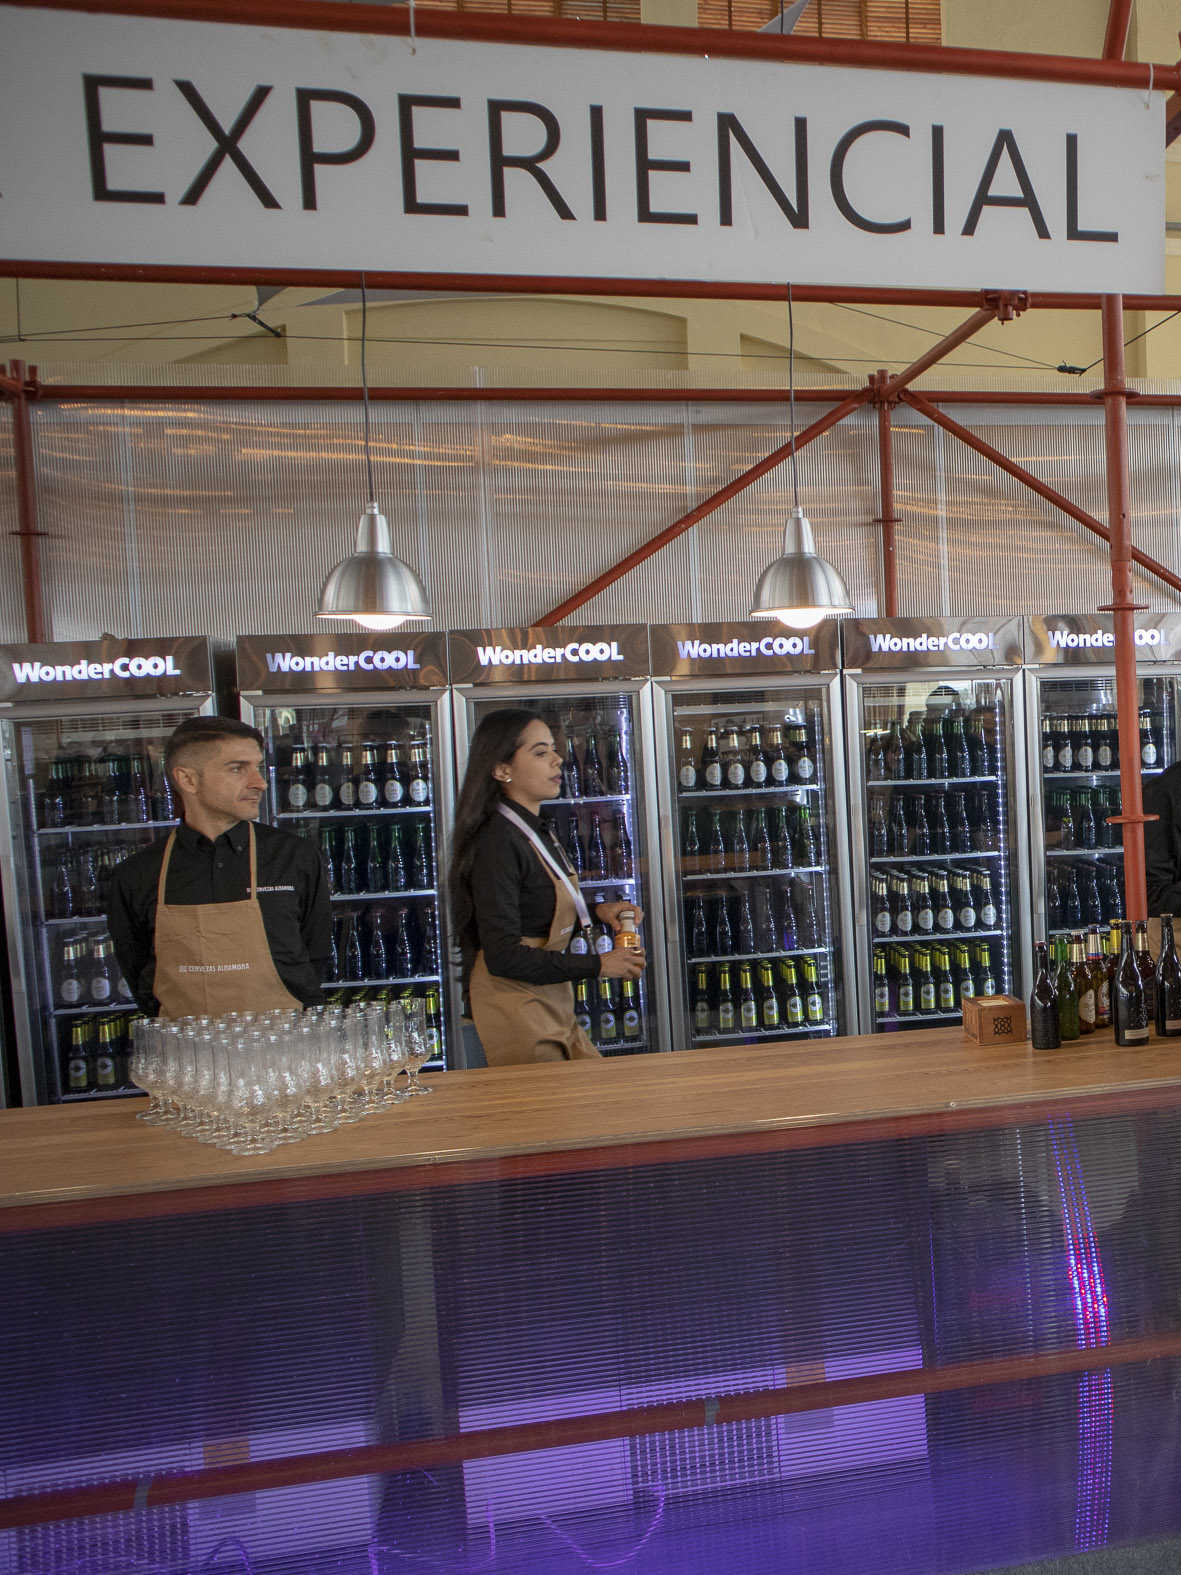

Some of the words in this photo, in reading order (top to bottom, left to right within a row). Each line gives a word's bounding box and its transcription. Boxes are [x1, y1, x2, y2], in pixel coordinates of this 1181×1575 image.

[82, 73, 1118, 242] EXPERIENCIAL
[677, 636, 815, 659] WonderCOOL
[868, 632, 1000, 652] WonderCOOL
[1048, 628, 1169, 648] WondeOOL
[266, 649, 420, 672] WonderCOOL
[477, 642, 624, 666] WonderCOOL
[12, 655, 181, 683] WonderCOOL
